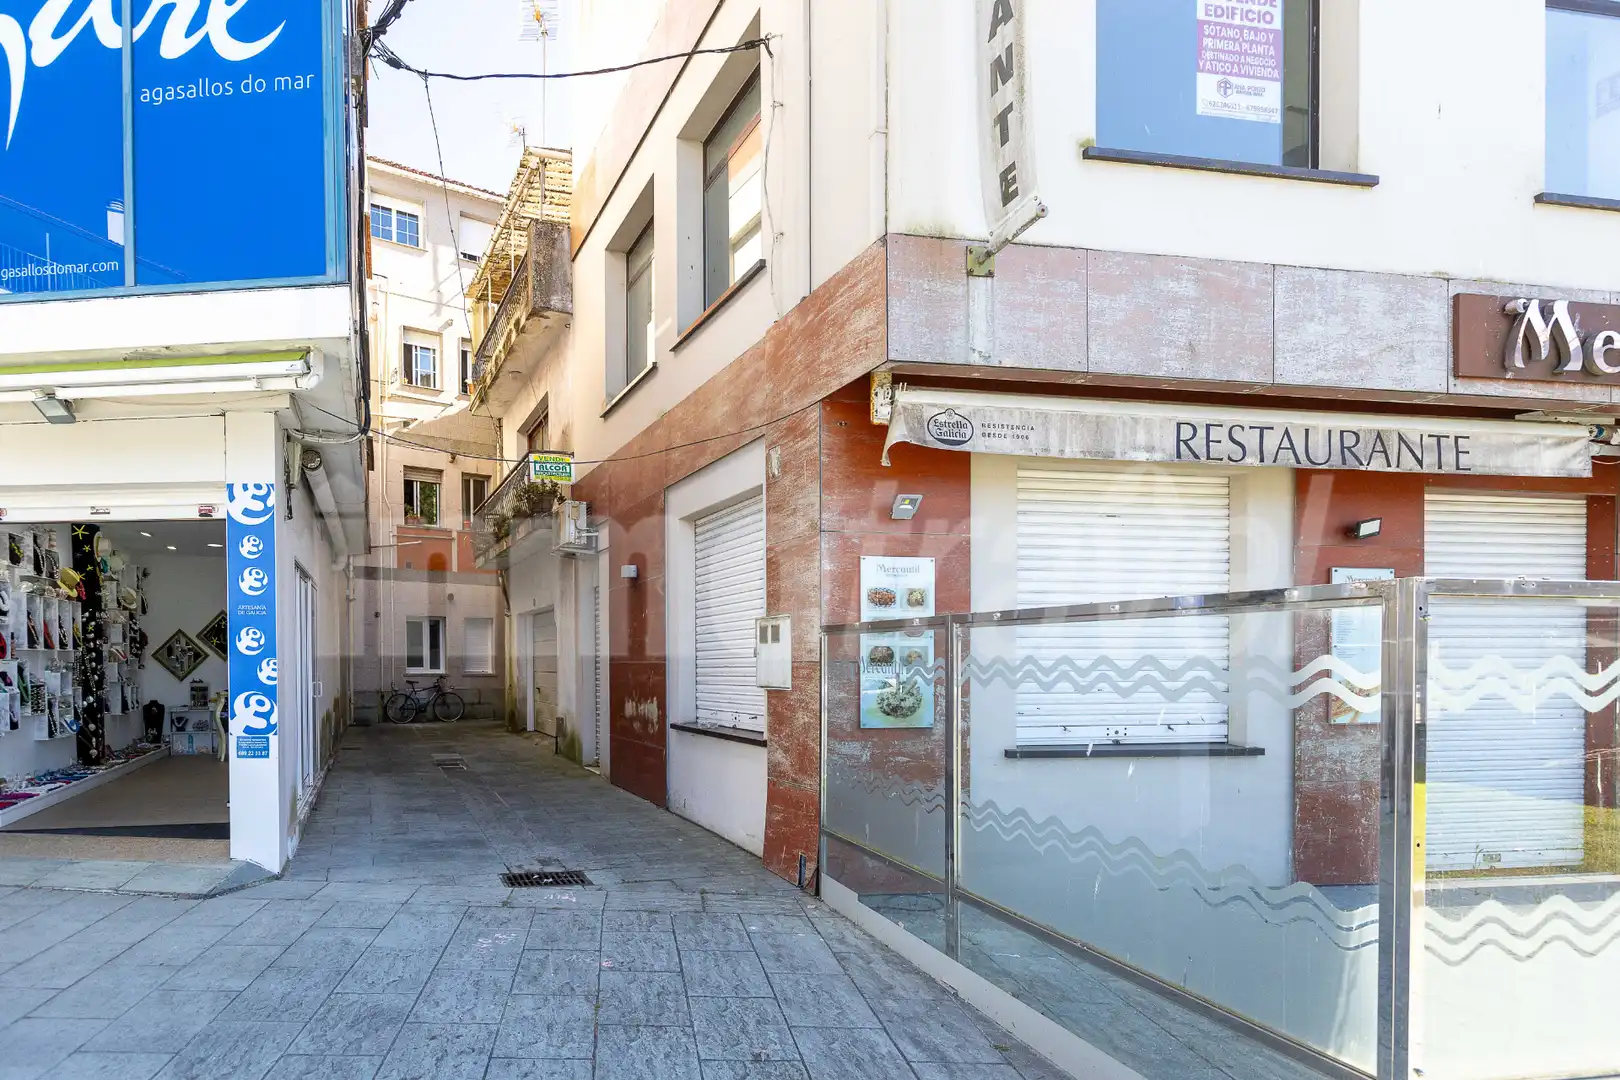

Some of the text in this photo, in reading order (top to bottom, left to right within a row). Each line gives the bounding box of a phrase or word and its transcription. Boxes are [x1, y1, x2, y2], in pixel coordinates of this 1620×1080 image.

[1204, 3, 1274, 24] EDIFICIO
[1243, 29, 1267, 42] BAJO
[1268, 32, 1274, 43] Y
[1202, 37, 1275, 56] PRIMERA PLANTA
[1201, 50, 1276, 68] DESTINADO A NEGOCIO
[1198, 60, 1203, 69] Y
[1233, 64, 1238, 74] A
[1240, 64, 1280, 79] VIVIENDA
[140, 74, 315, 105] agasallos do mar
[933, 418, 968, 430] Estrella
[935, 427, 967, 439] Galicia
[981, 423, 1035, 431] RESISTENCIA
[1012, 433, 1030, 441] 1906
[1175, 421, 1472, 471] RESTAURANTE
